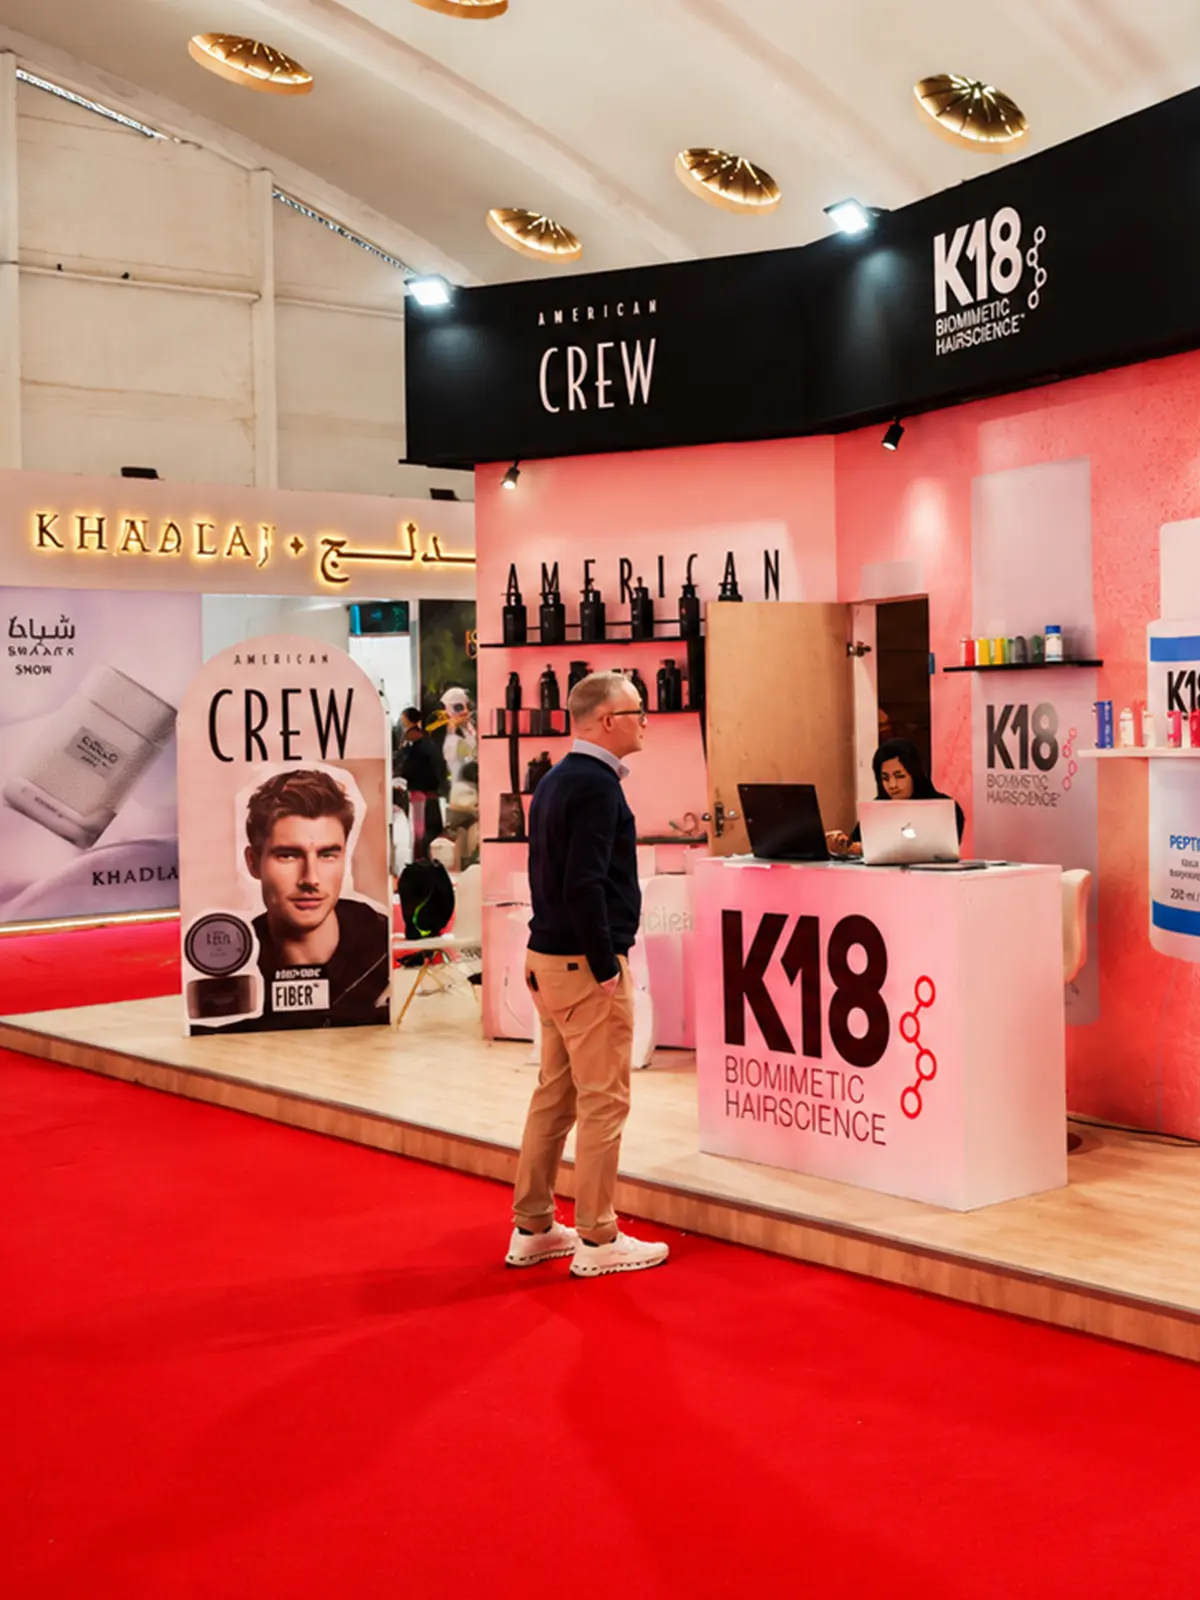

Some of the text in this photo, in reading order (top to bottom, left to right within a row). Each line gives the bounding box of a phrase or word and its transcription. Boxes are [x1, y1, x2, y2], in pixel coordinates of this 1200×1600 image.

[933, 206, 1023, 314] K18
[538, 299, 657, 326] AMERICAN
[936, 298, 1010, 337] BIOMIMETIC
[539, 337, 656, 413] CREW
[506, 549, 780, 604] AMERICAN
[234, 653, 329, 665] AMERICAN
[208, 688, 354, 762] CREW
[986, 702, 1060, 771] K18
[92, 866, 179, 886] KHADLA
[721, 909, 890, 1068] K18
[725, 1055, 865, 1104] BIOMIMETIC
[725, 1089, 887, 1146] HAIRSCIENCE
